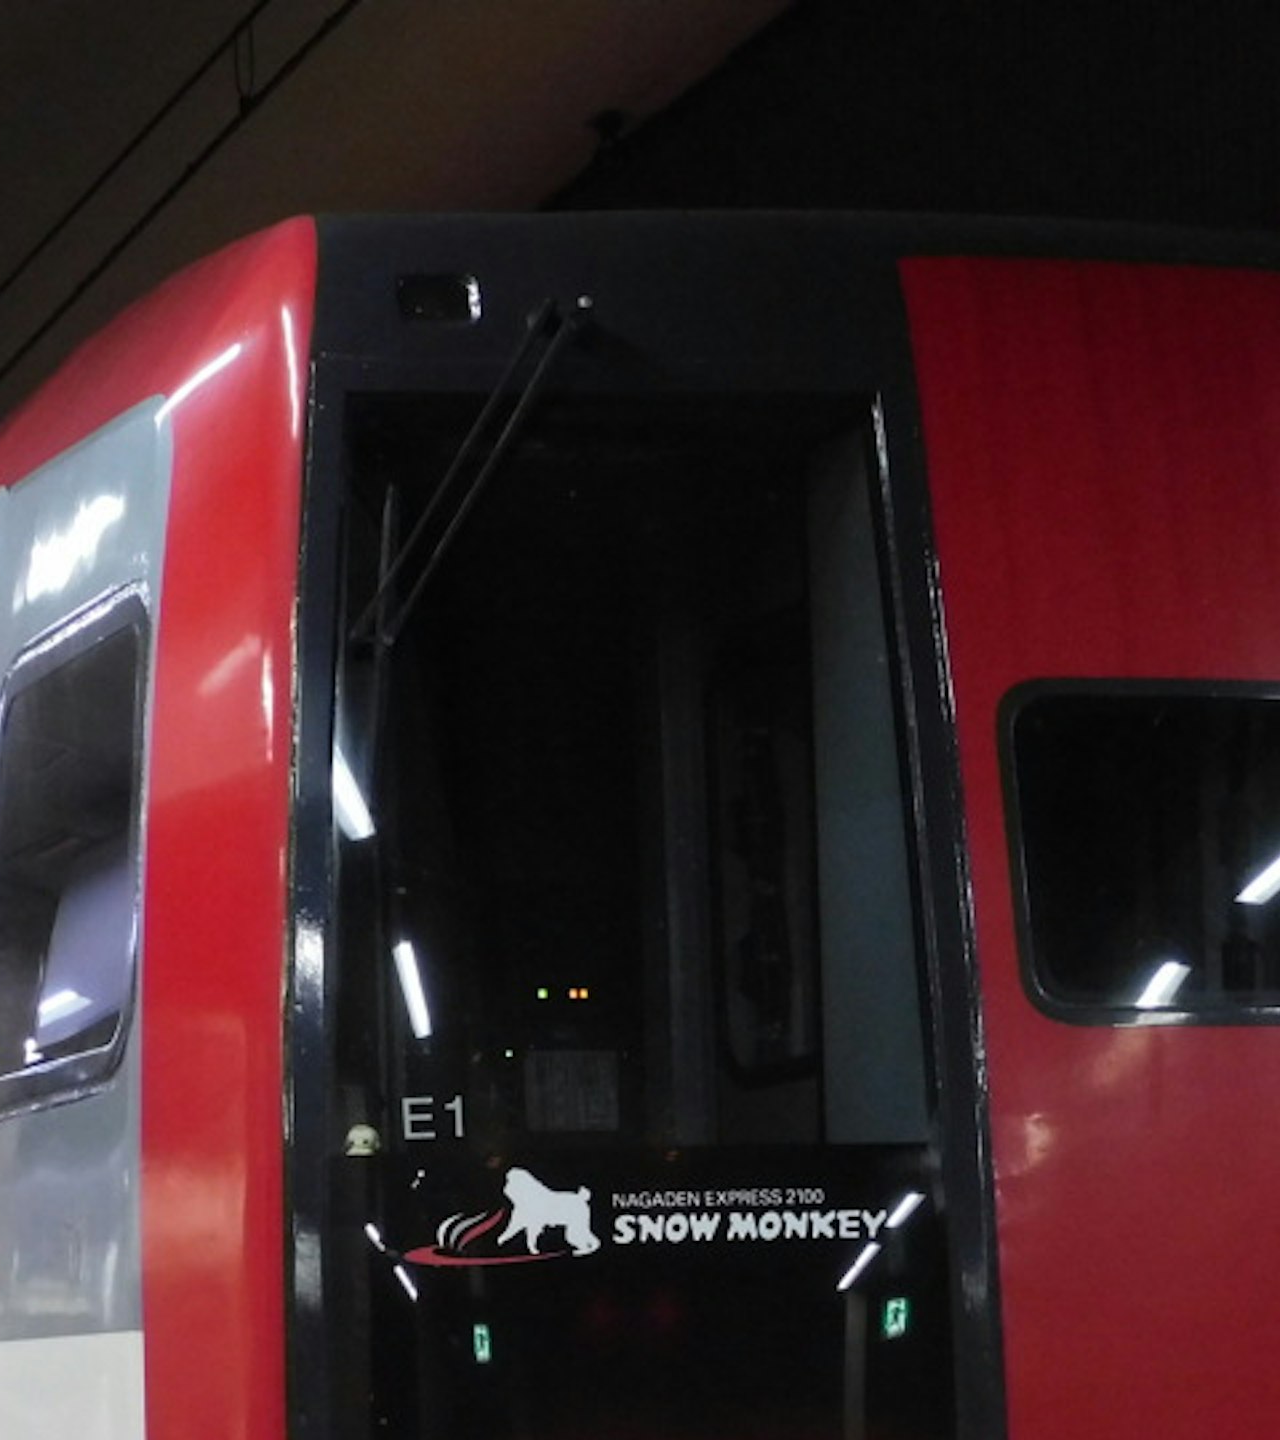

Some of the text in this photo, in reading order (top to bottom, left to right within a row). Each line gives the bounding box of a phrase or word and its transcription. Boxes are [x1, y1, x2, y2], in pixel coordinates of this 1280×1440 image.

[400, 1095, 465, 1141] E1
[611, 1187, 826, 1209] NAGADEN EXPRESS 2100
[611, 1208, 888, 1245] SNOW MONKEY
